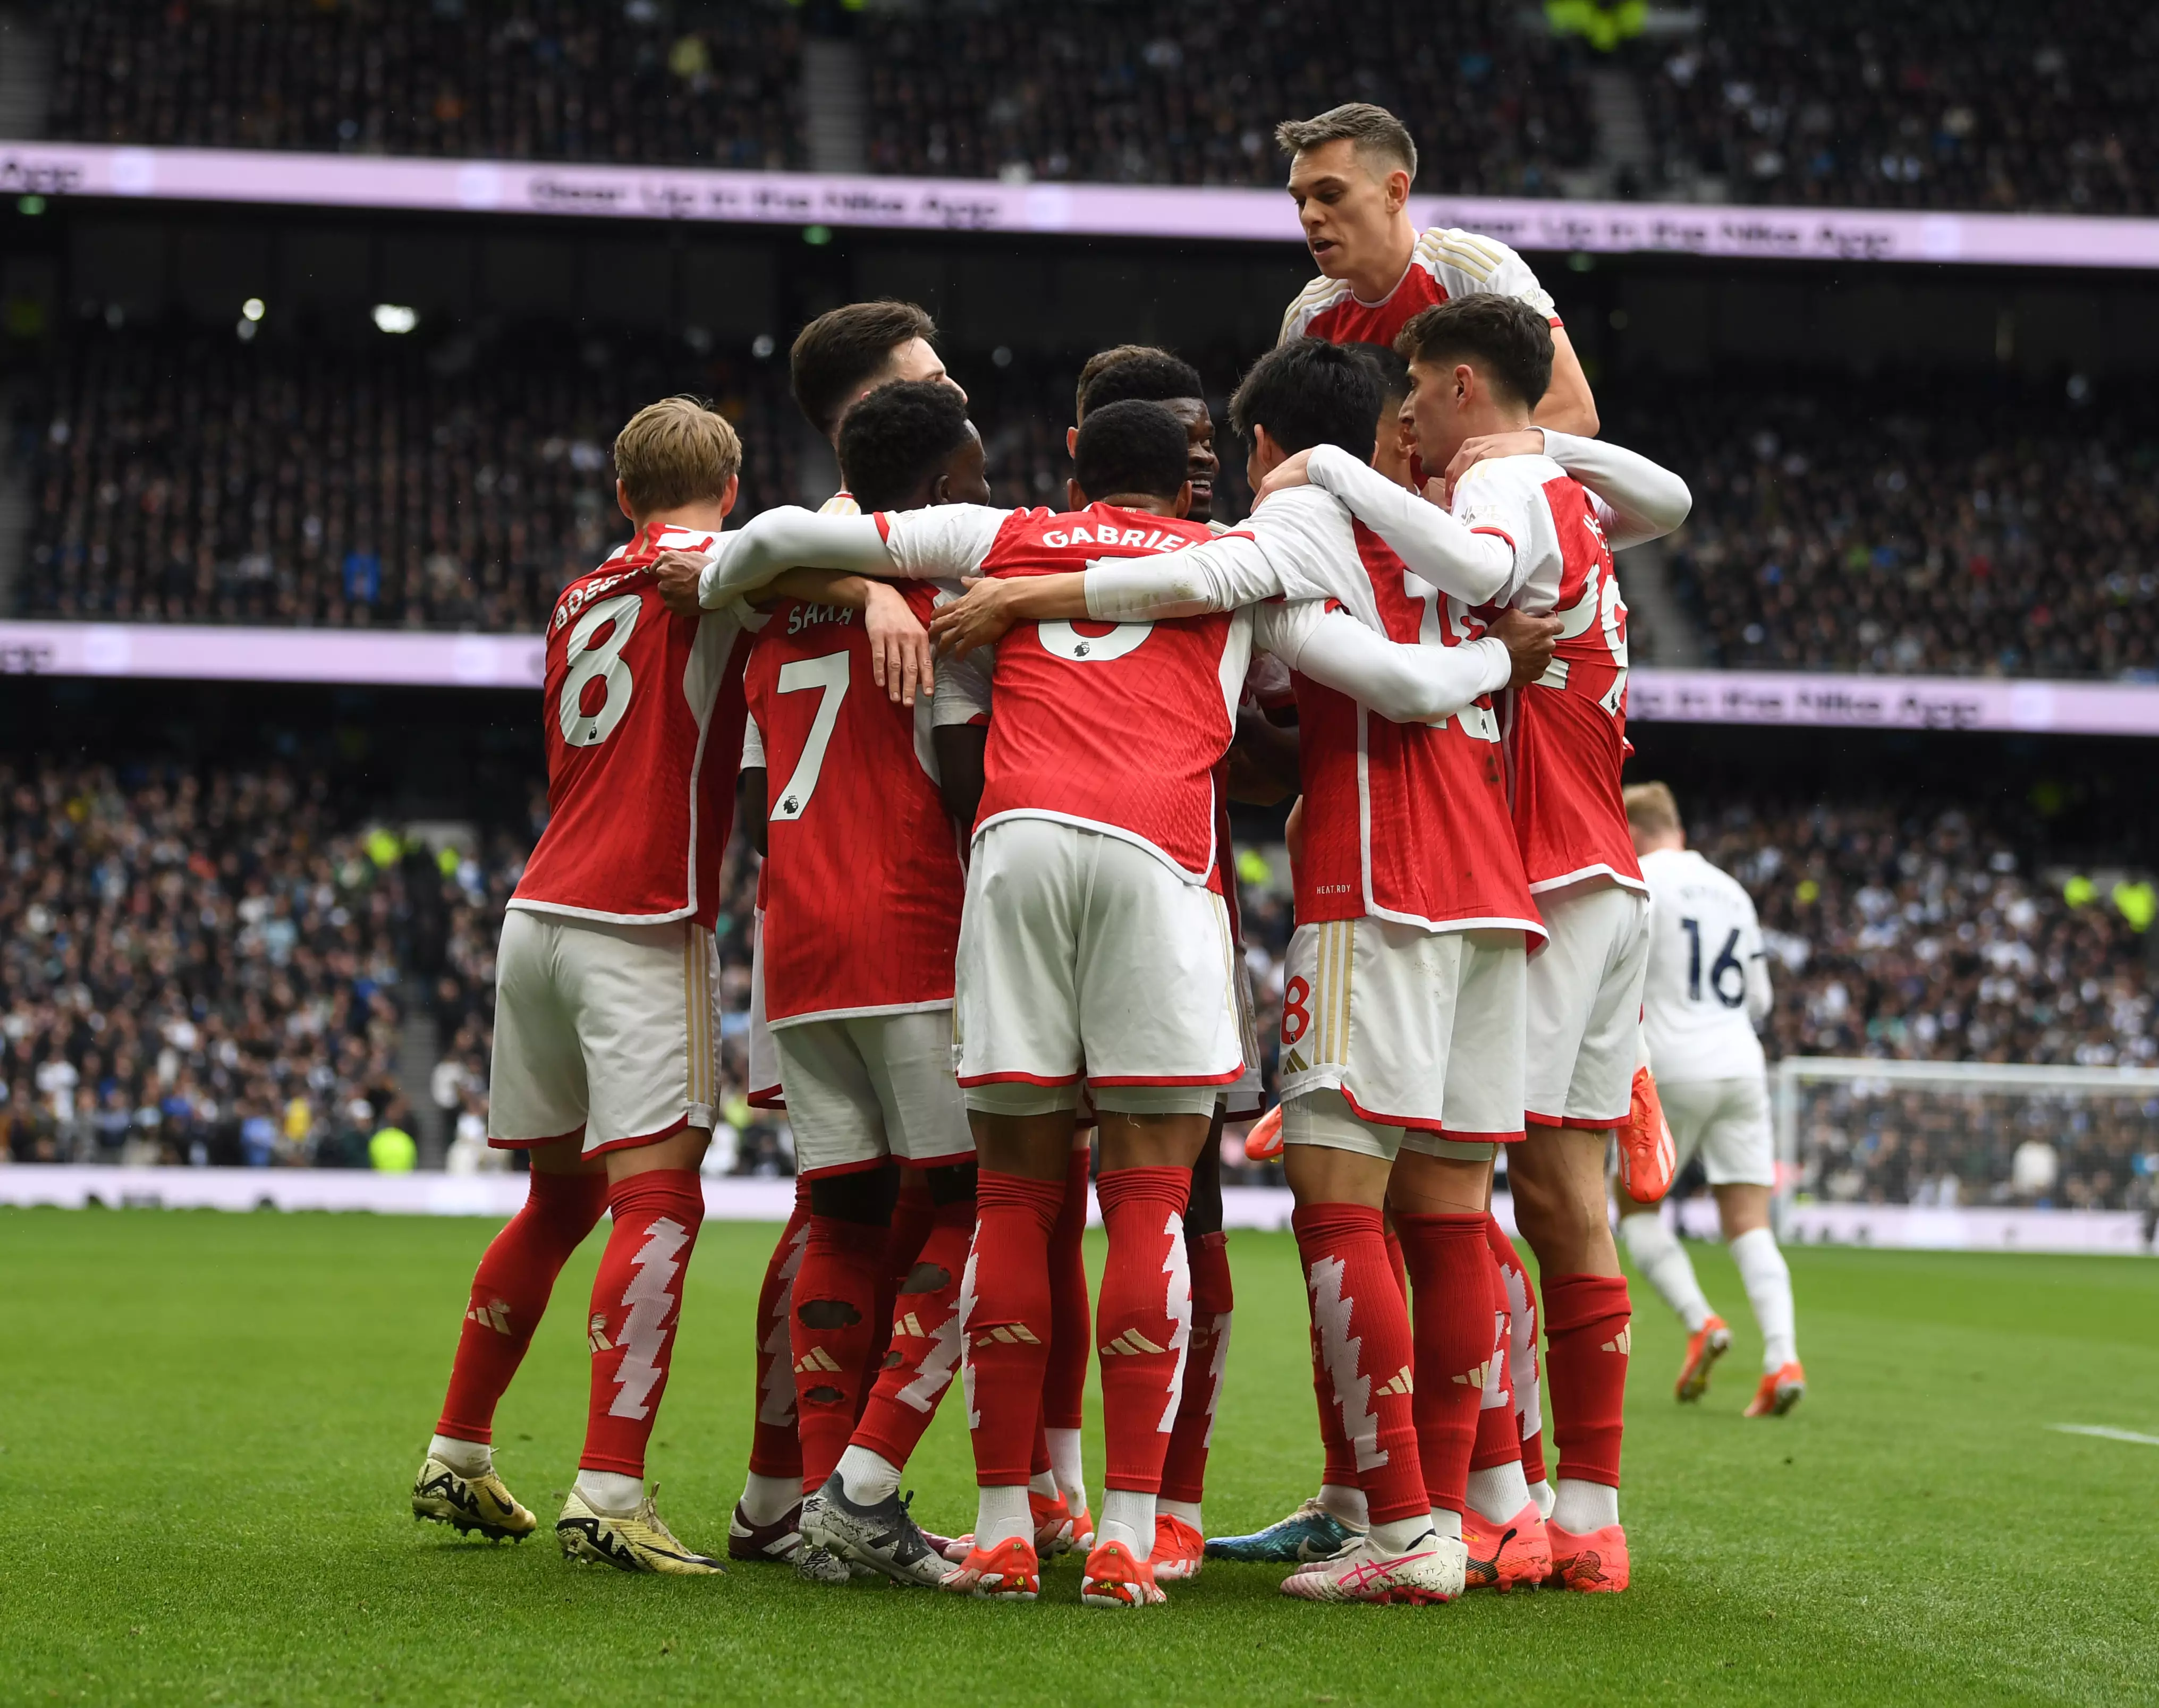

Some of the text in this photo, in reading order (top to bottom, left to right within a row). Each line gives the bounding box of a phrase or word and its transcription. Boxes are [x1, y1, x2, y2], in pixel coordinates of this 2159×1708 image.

[560, 594, 642, 747] 8
[769, 650, 850, 822] 7
[1316, 884, 1351, 894] HEAT.RDY
[1681, 918, 1745, 1008] 16
[1281, 975, 1310, 1045] 8
